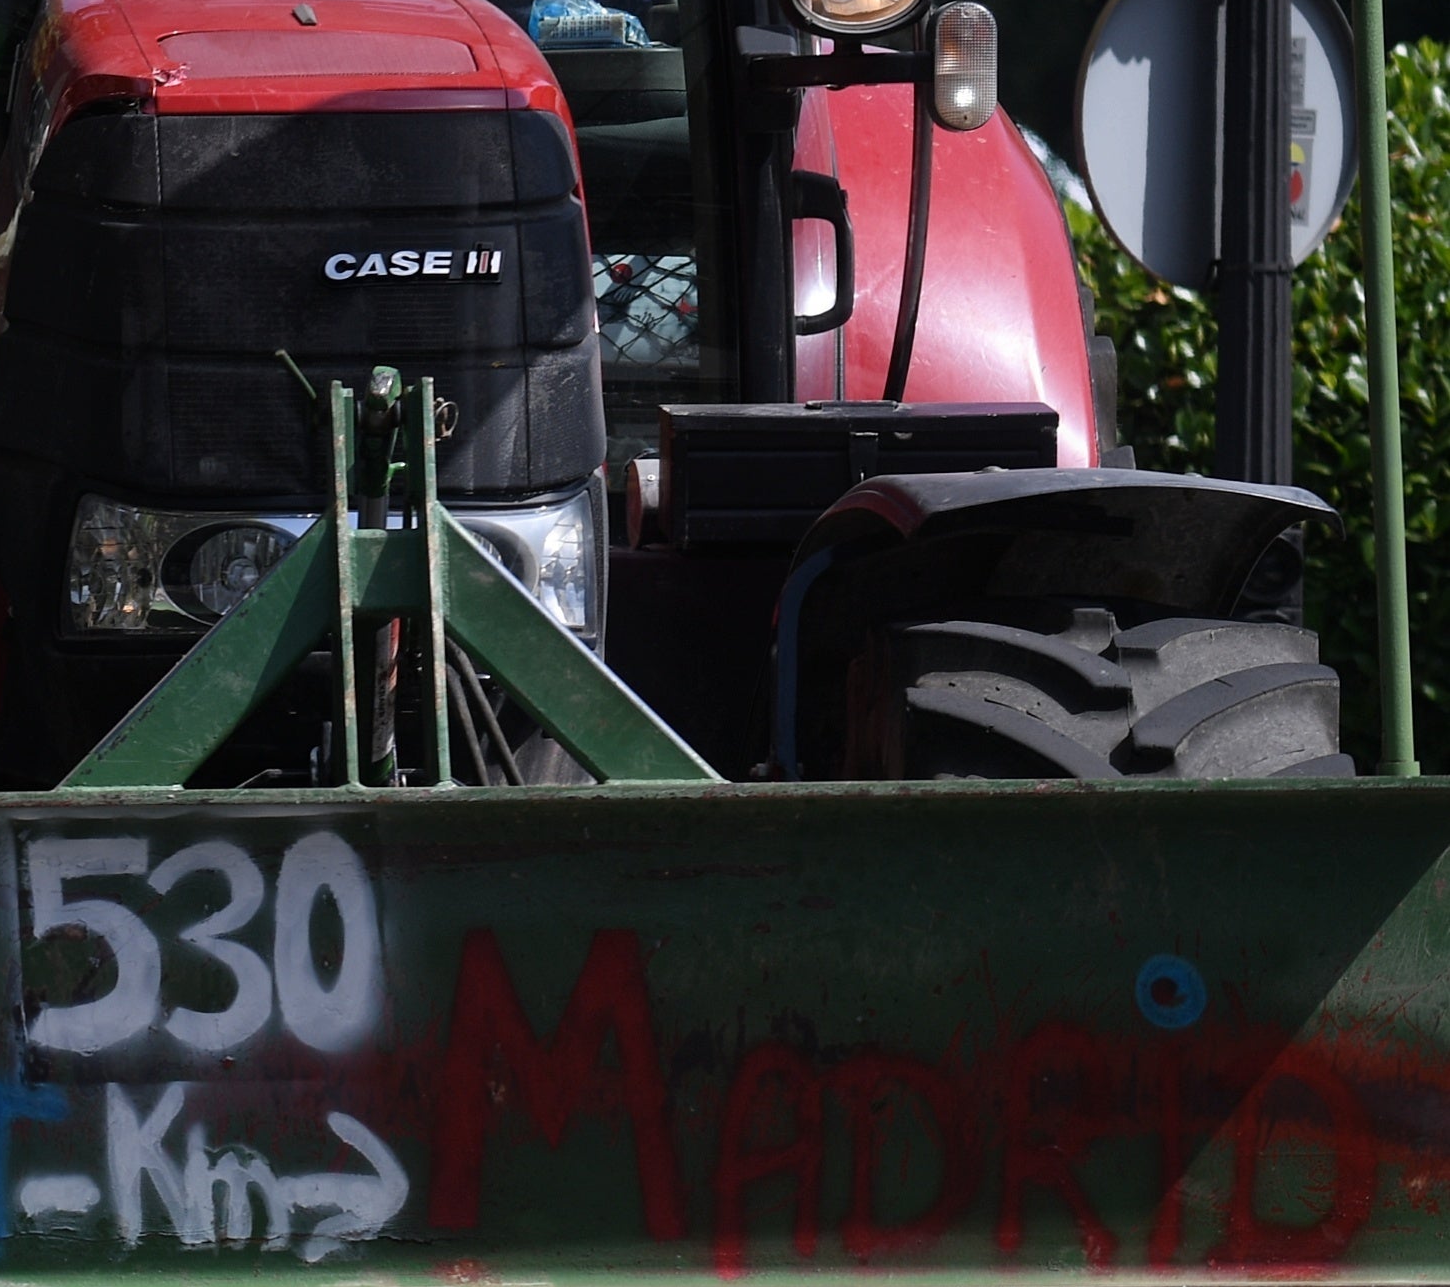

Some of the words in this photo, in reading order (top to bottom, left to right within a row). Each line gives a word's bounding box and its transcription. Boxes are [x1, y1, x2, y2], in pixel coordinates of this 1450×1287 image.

[324, 250, 453, 280] CASE
[21, 831, 383, 1058] 530
[102, 1080, 291, 1252] Km
